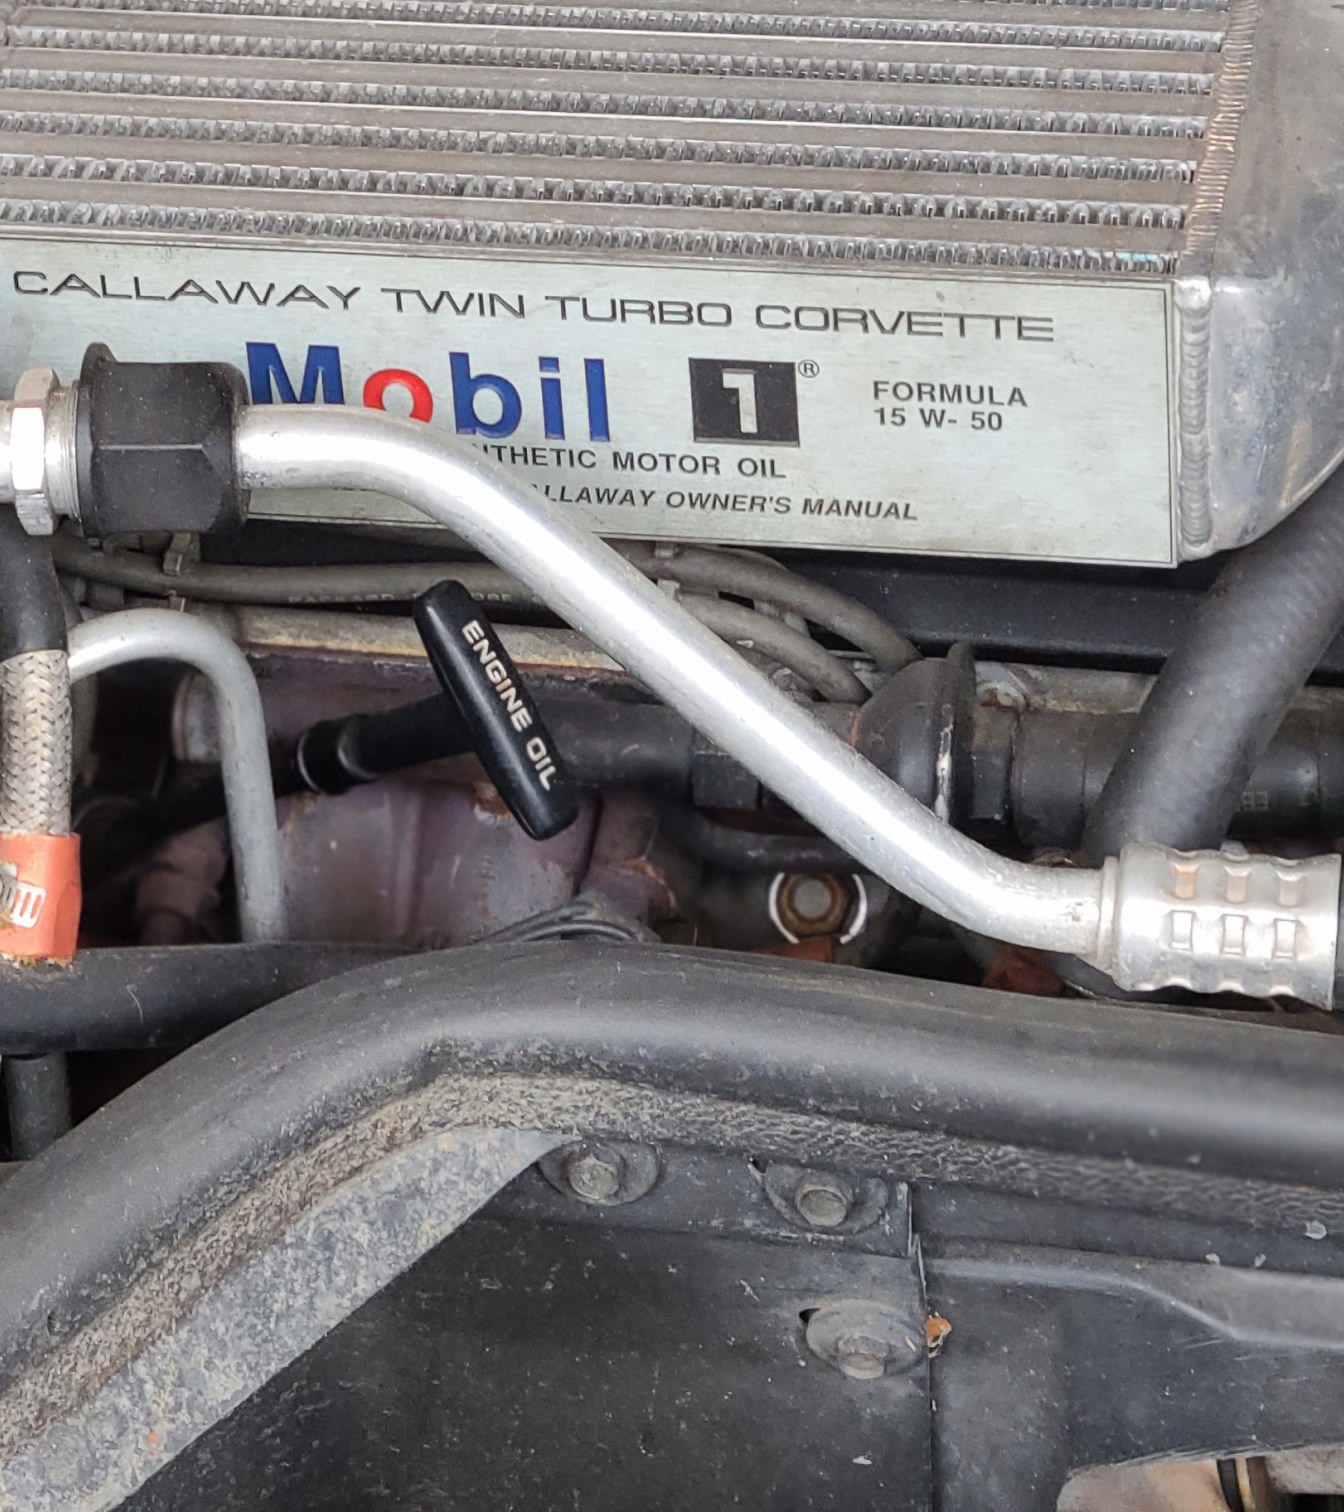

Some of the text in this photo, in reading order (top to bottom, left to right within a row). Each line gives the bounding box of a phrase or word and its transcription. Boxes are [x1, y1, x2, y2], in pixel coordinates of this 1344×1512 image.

[12, 270, 1055, 343] CALLAWAY TWIN TURBO CORVETTE
[244, 340, 611, 443] Mobil
[872, 379, 1029, 408] FORMULA
[873, 406, 907, 427] 15
[969, 410, 1003, 432] 50
[473, 443, 788, 479] THETIC MOTOR OIL
[530, 484, 919, 521] LLAWAY OWNER'S MANUAL
[461, 619, 533, 733] ENGINE
[526, 736, 556, 791] OIL
